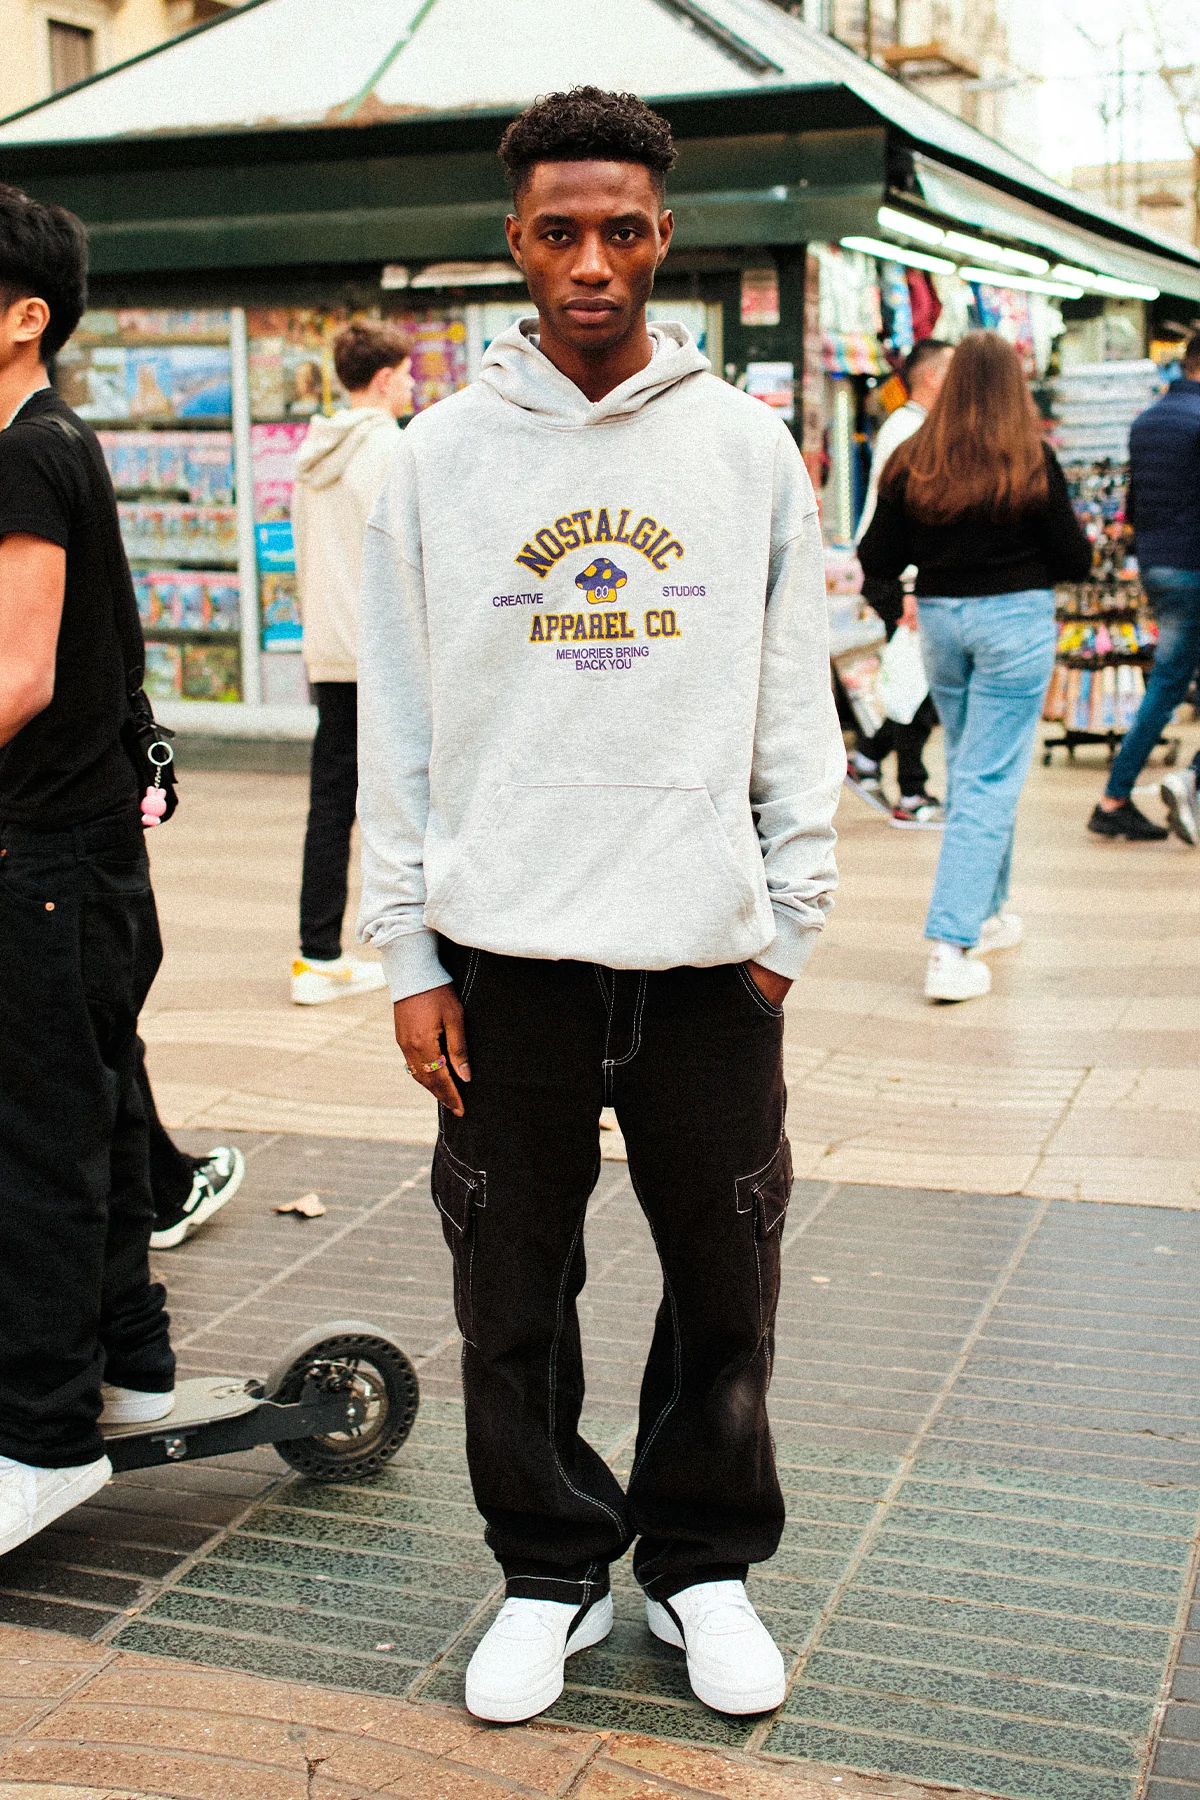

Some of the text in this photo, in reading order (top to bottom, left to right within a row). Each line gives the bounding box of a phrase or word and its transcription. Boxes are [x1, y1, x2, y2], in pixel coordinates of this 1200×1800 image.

[514, 508, 685, 580] NOSTALGIC
[662, 585, 706, 597] STUDIOS
[492, 593, 544, 607] CREATIVE
[529, 608, 682, 642] APPAREL CO.
[556, 646, 650, 660] MEMORIES BRING
[575, 659, 632, 670] BACK YOU
